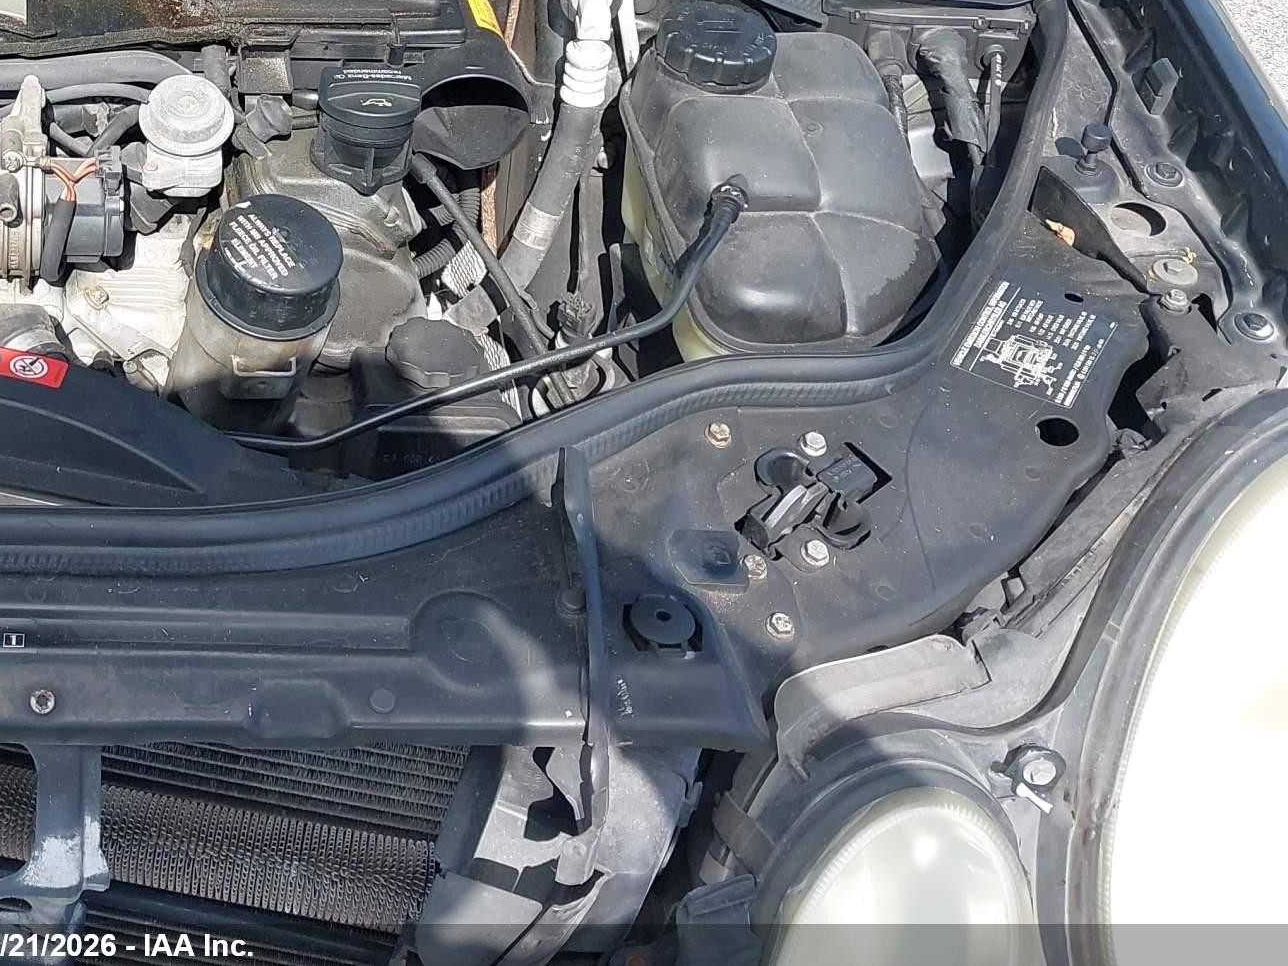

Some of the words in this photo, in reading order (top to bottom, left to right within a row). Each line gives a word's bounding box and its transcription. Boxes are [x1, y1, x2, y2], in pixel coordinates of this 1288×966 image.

[229, 221, 252, 245] FLEECE
[248, 242, 260, 256] OIL
[257, 254, 278, 280] FILTER
[231, 238, 260, 269] ELEMENT
[237, 215, 253, 231] WITH
[258, 239, 289, 277] APPROVED
[248, 214, 272, 236] ALWAYS
[268, 235, 296, 269] REPLACE
